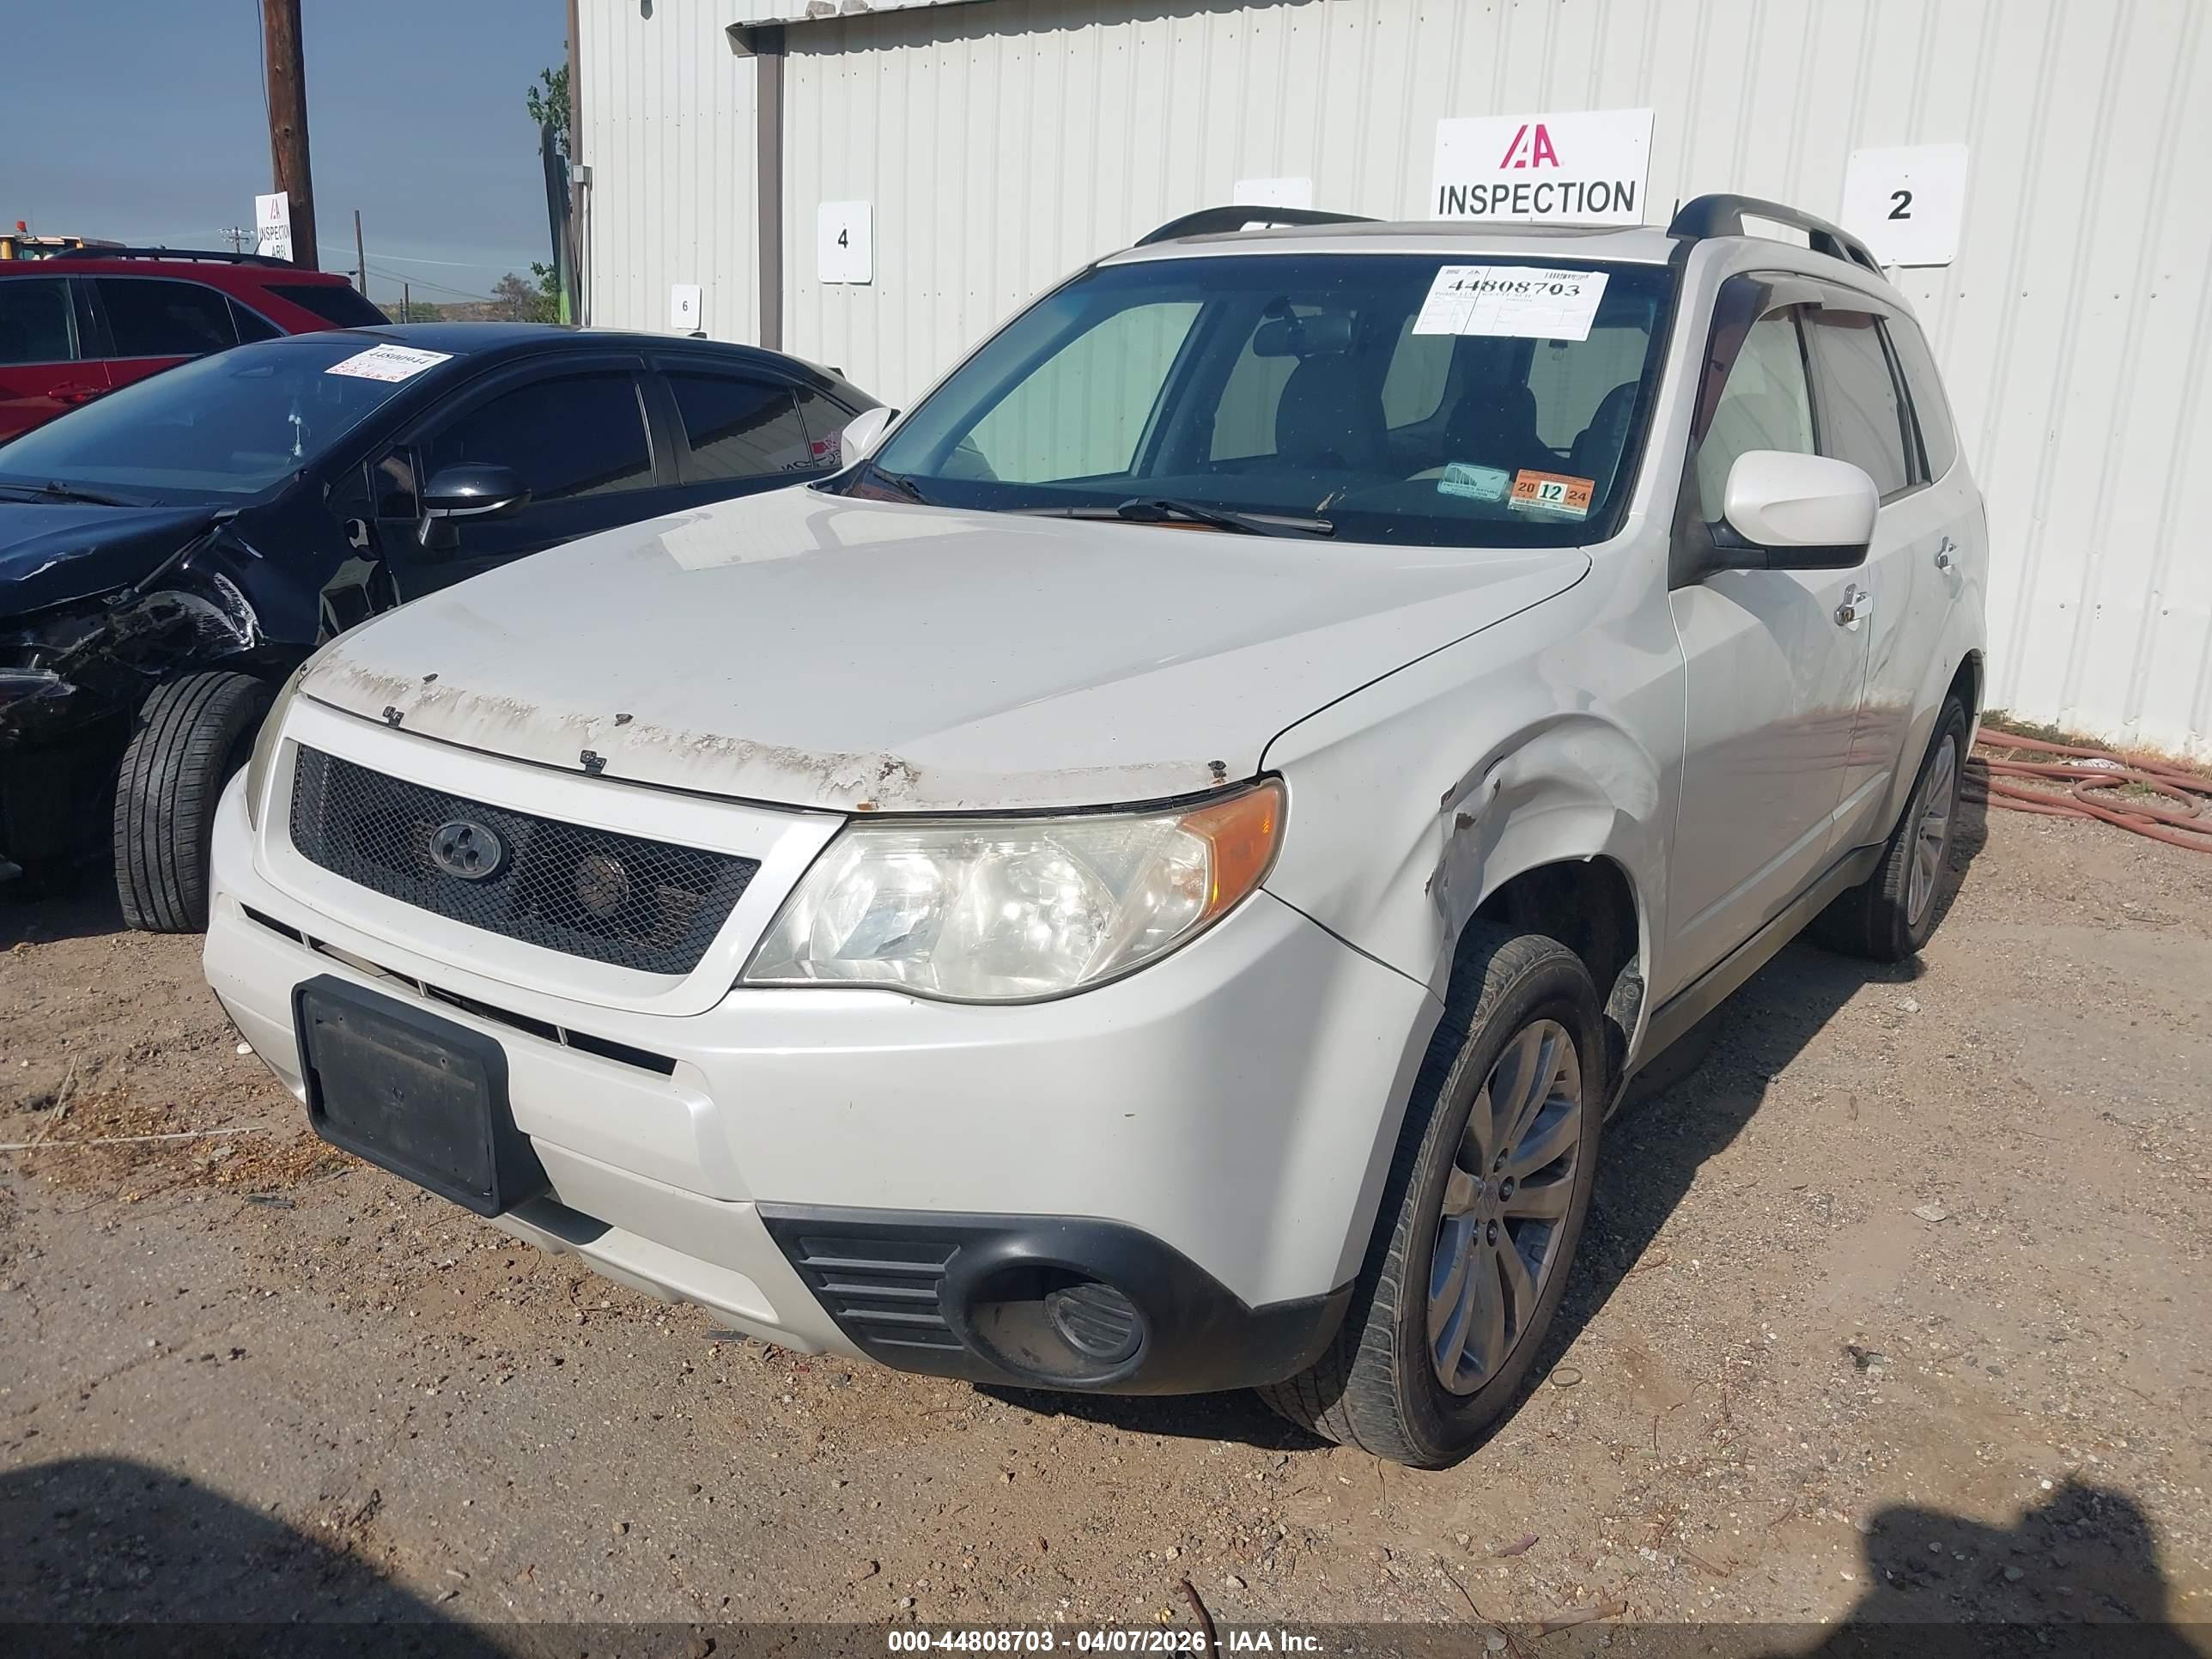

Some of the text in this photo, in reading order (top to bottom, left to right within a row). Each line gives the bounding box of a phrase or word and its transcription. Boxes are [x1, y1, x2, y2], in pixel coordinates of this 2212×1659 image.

[1438, 180, 1636, 216] INSPECTION
[1887, 190, 1913, 221] 2
[837, 228, 848, 249] 4
[1448, 278, 1581, 298] 44808703
[682, 301, 689, 312] 6
[1517, 482, 1587, 501] 20 12 24
